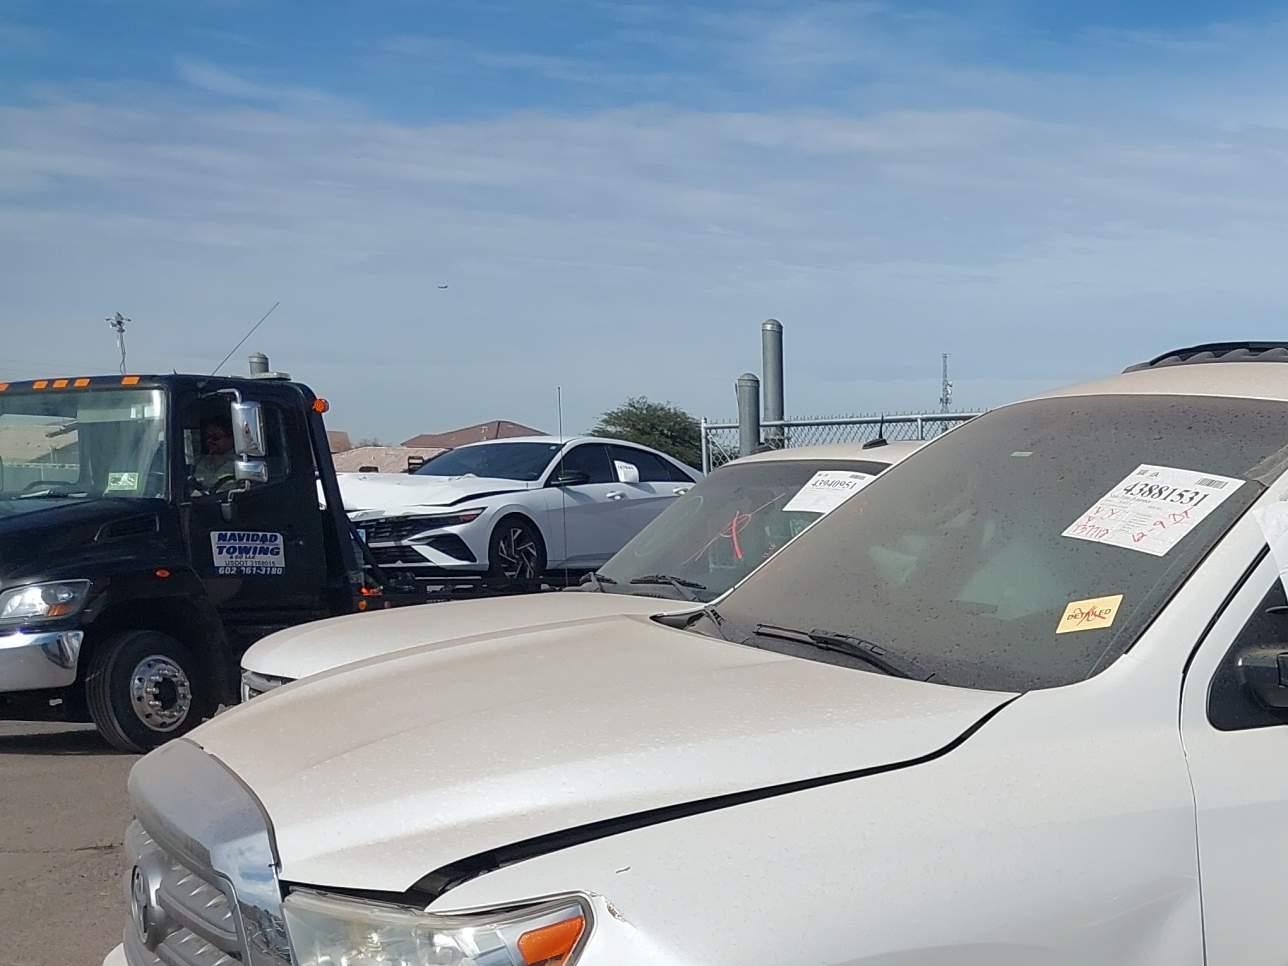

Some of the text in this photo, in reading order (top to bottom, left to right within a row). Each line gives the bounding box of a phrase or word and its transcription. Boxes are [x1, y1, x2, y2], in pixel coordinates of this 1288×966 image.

[1123, 481, 1210, 507] 43881531
[217, 532, 279, 543] NAVIDAD
[216, 545, 281, 556] TOWING
